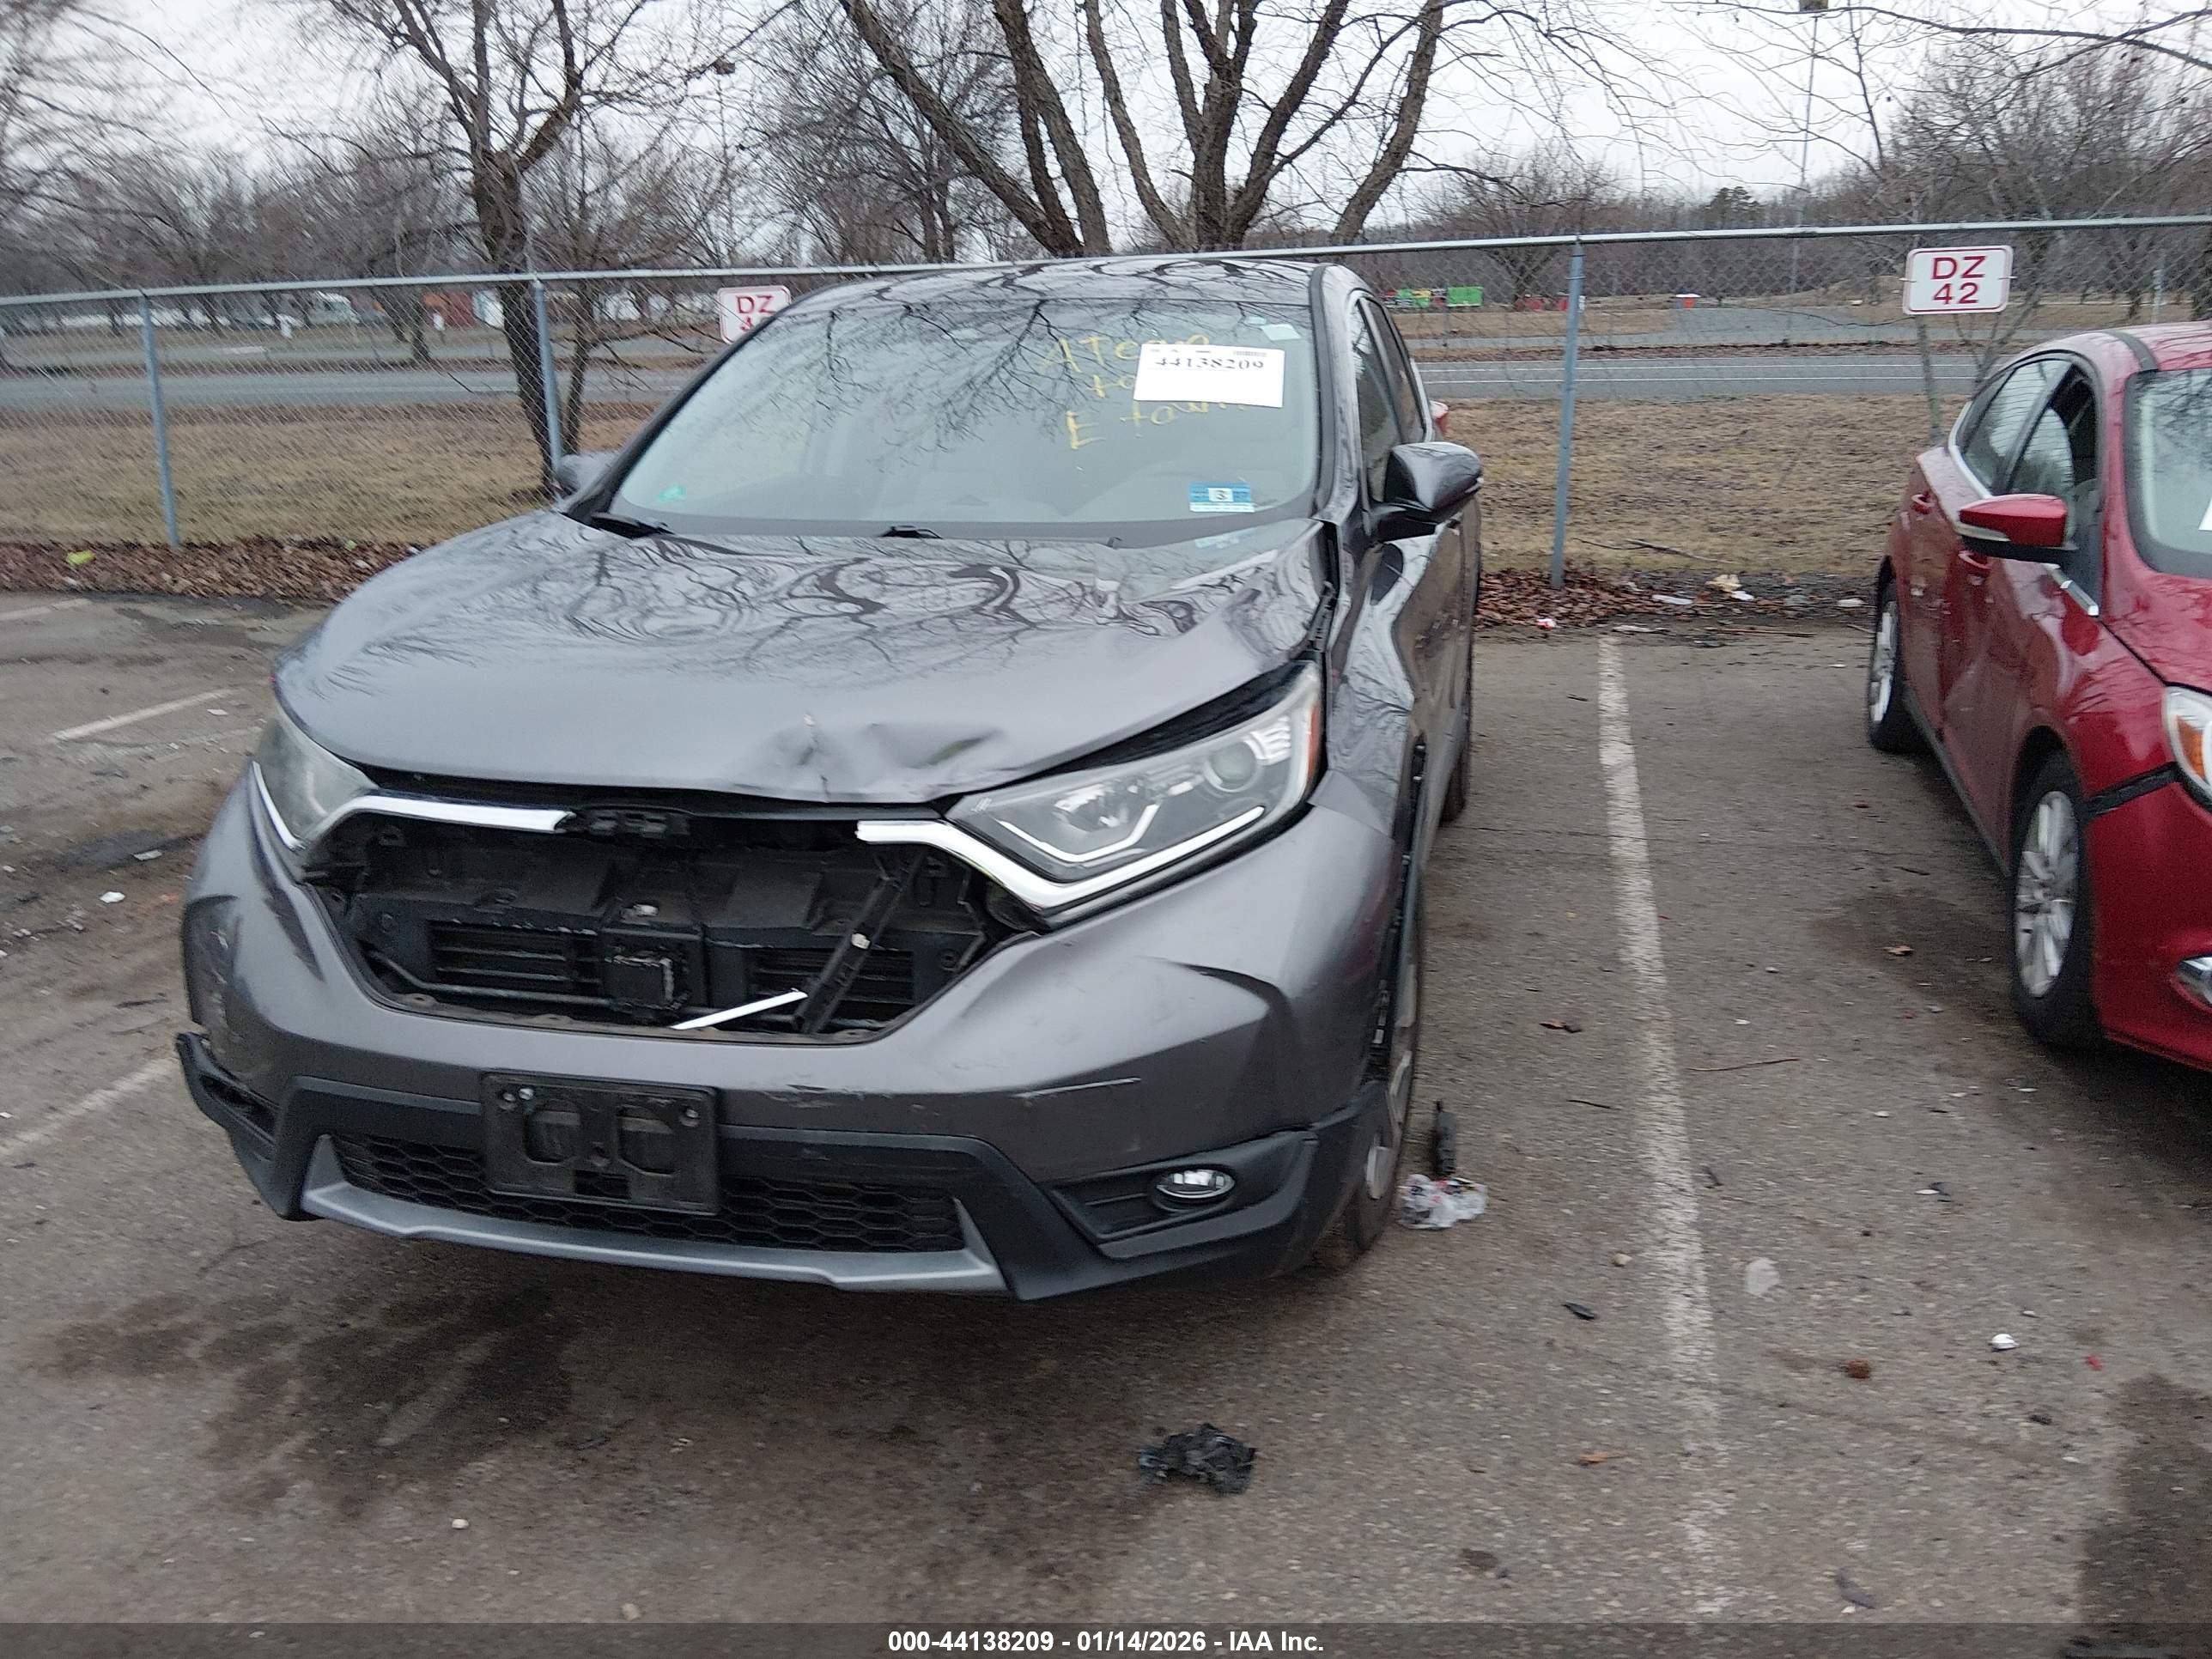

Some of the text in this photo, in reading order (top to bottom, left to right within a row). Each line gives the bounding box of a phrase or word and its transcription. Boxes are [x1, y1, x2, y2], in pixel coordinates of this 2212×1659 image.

[1931, 255, 1986, 279] DZ
[1933, 282, 1979, 305] 42
[736, 295, 776, 314] DZ
[1155, 357, 1265, 370] 44138209
